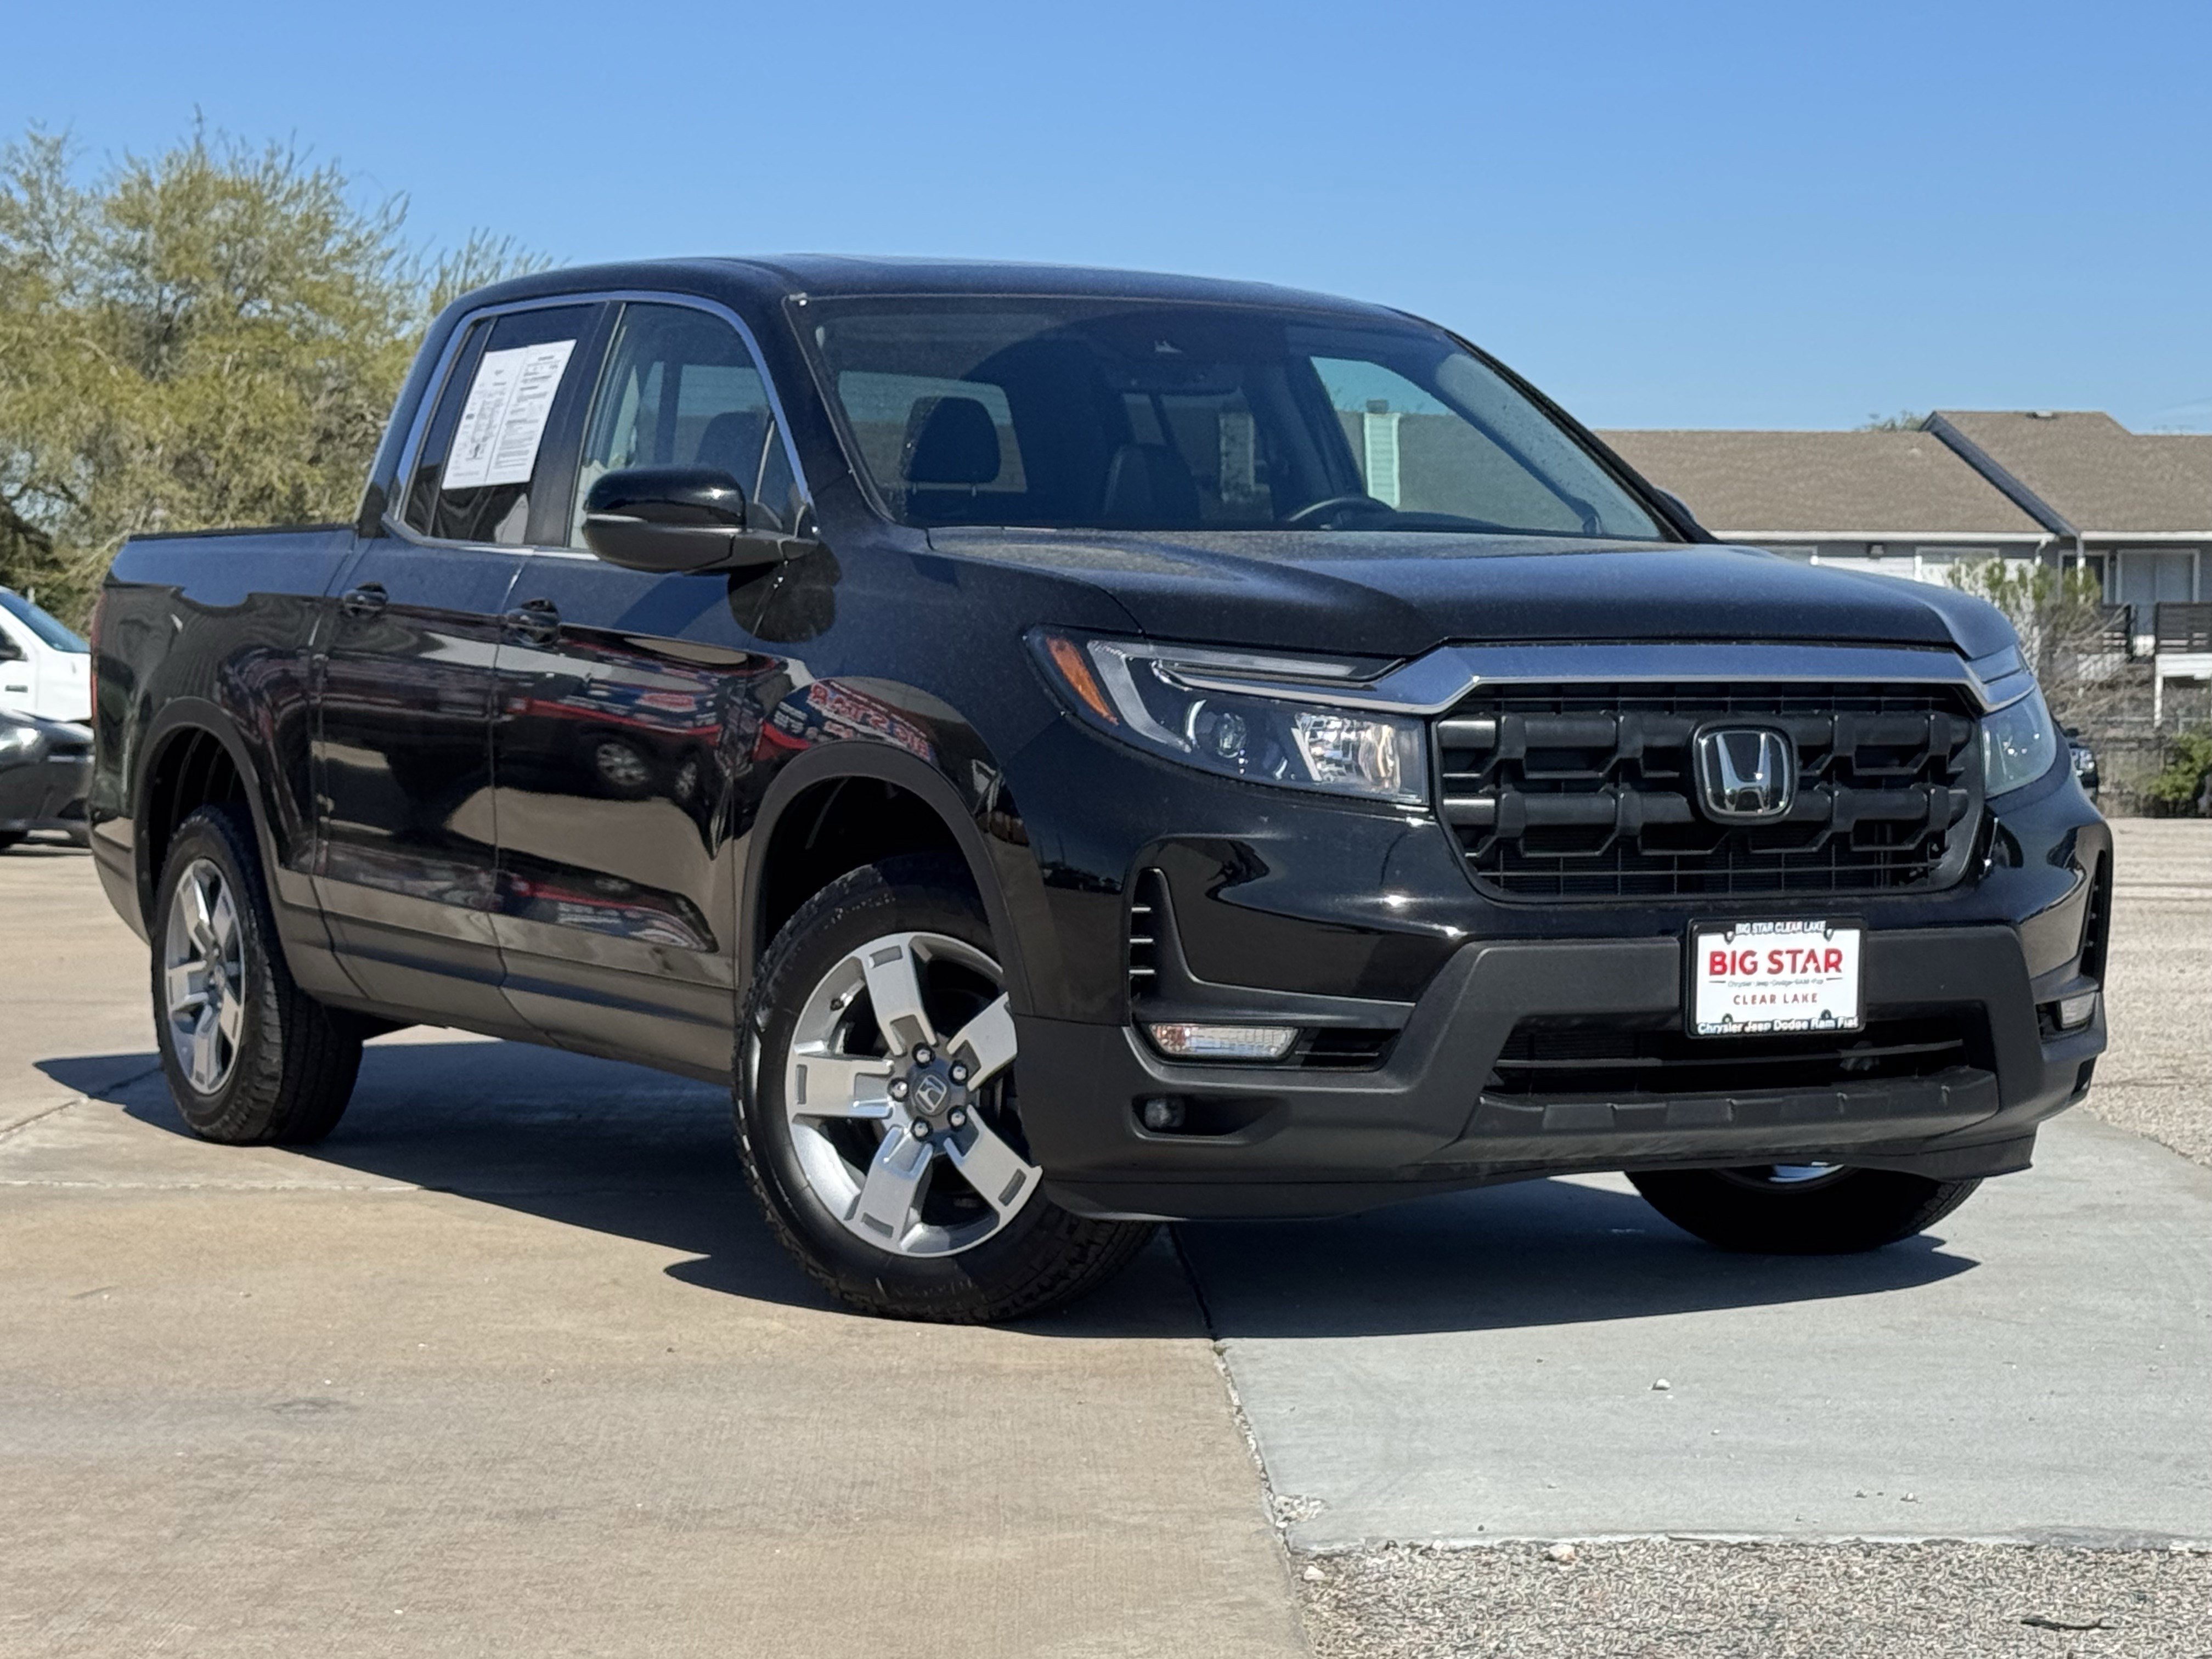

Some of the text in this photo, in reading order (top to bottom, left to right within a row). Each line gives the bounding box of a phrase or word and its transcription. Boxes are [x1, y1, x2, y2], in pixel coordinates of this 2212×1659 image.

[1735, 921, 1826, 933] BIG STAR CLEAR LAKE
[1709, 948, 1842, 976] BIG STAR
[1733, 992, 1818, 1005] CLEAR LAKE
[1697, 1016, 1858, 1035] Chrysler Jeep Dodge Ram Fiat
